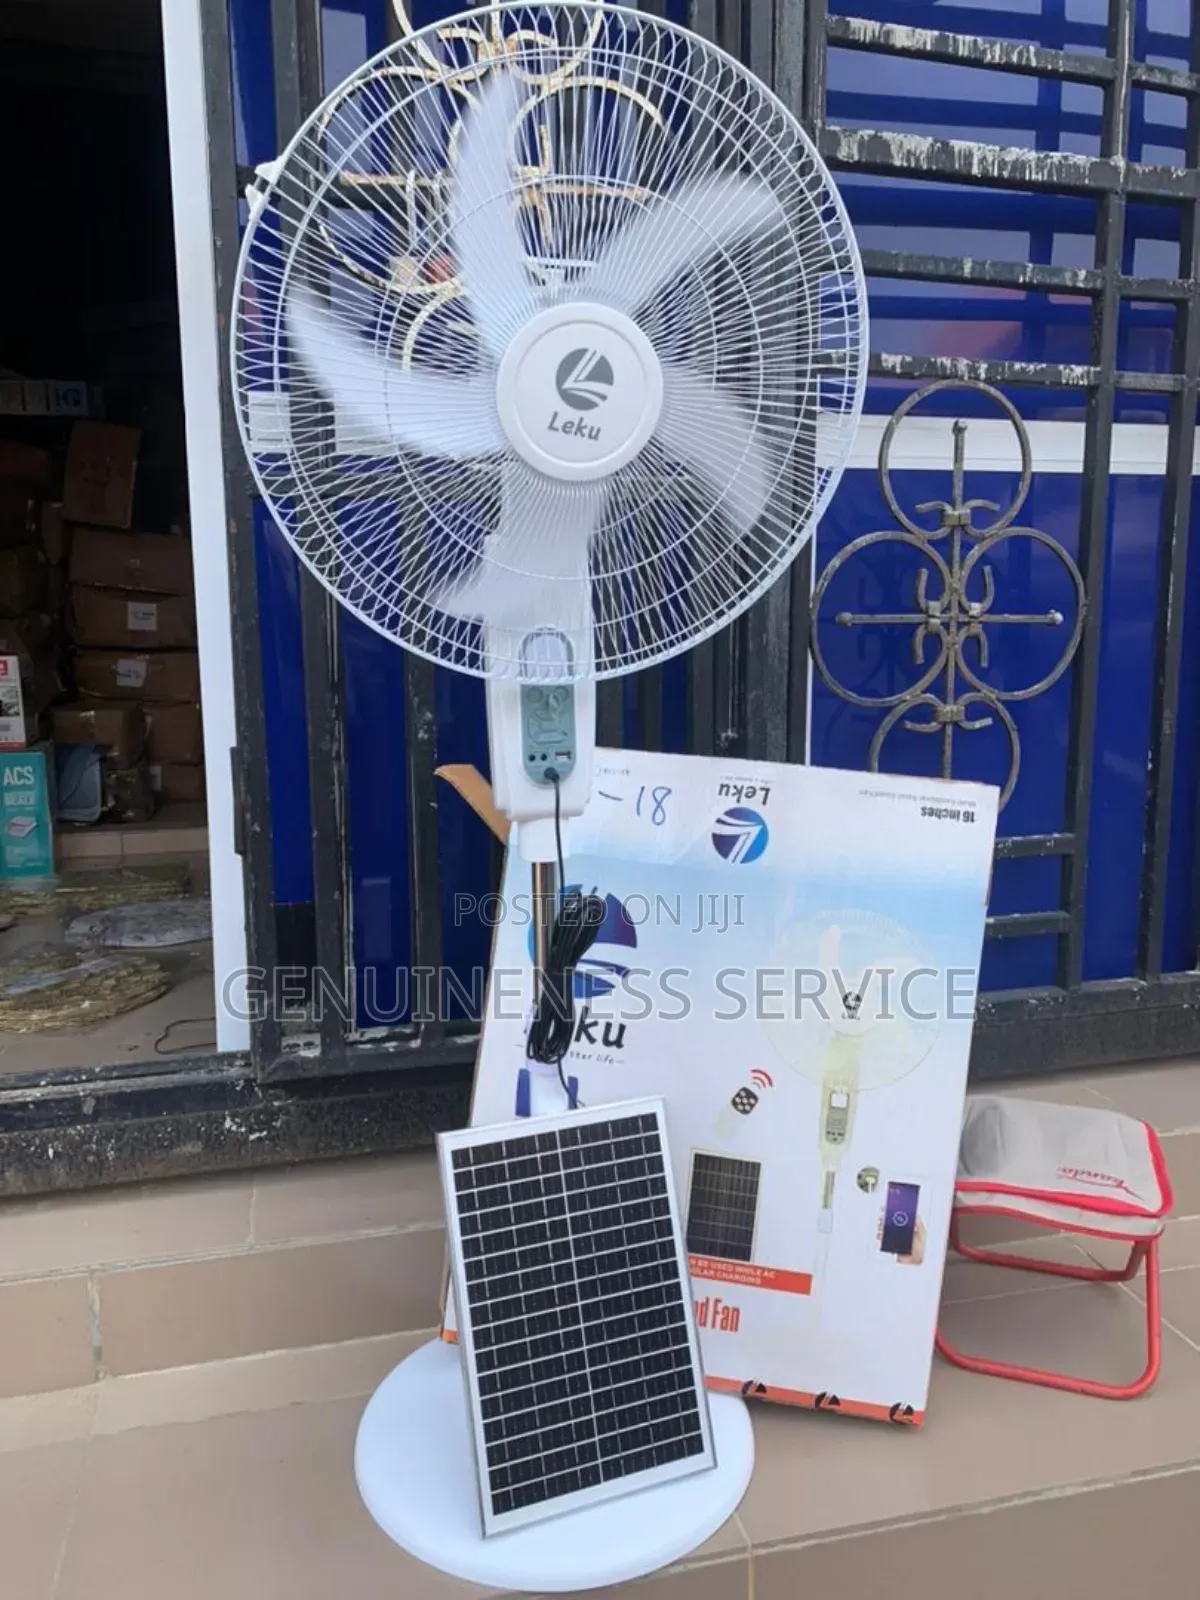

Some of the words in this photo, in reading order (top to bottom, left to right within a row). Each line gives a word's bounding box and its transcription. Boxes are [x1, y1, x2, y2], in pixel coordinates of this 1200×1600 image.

[547, 411, 602, 441] Leku
[3, 765, 35, 786] ACS
[718, 783, 771, 806] Leku
[920, 806, 961, 822] inches
[963, 811, 976, 823] 16
[711, 1261, 734, 1272] USED
[711, 1297, 740, 1332] Fan
